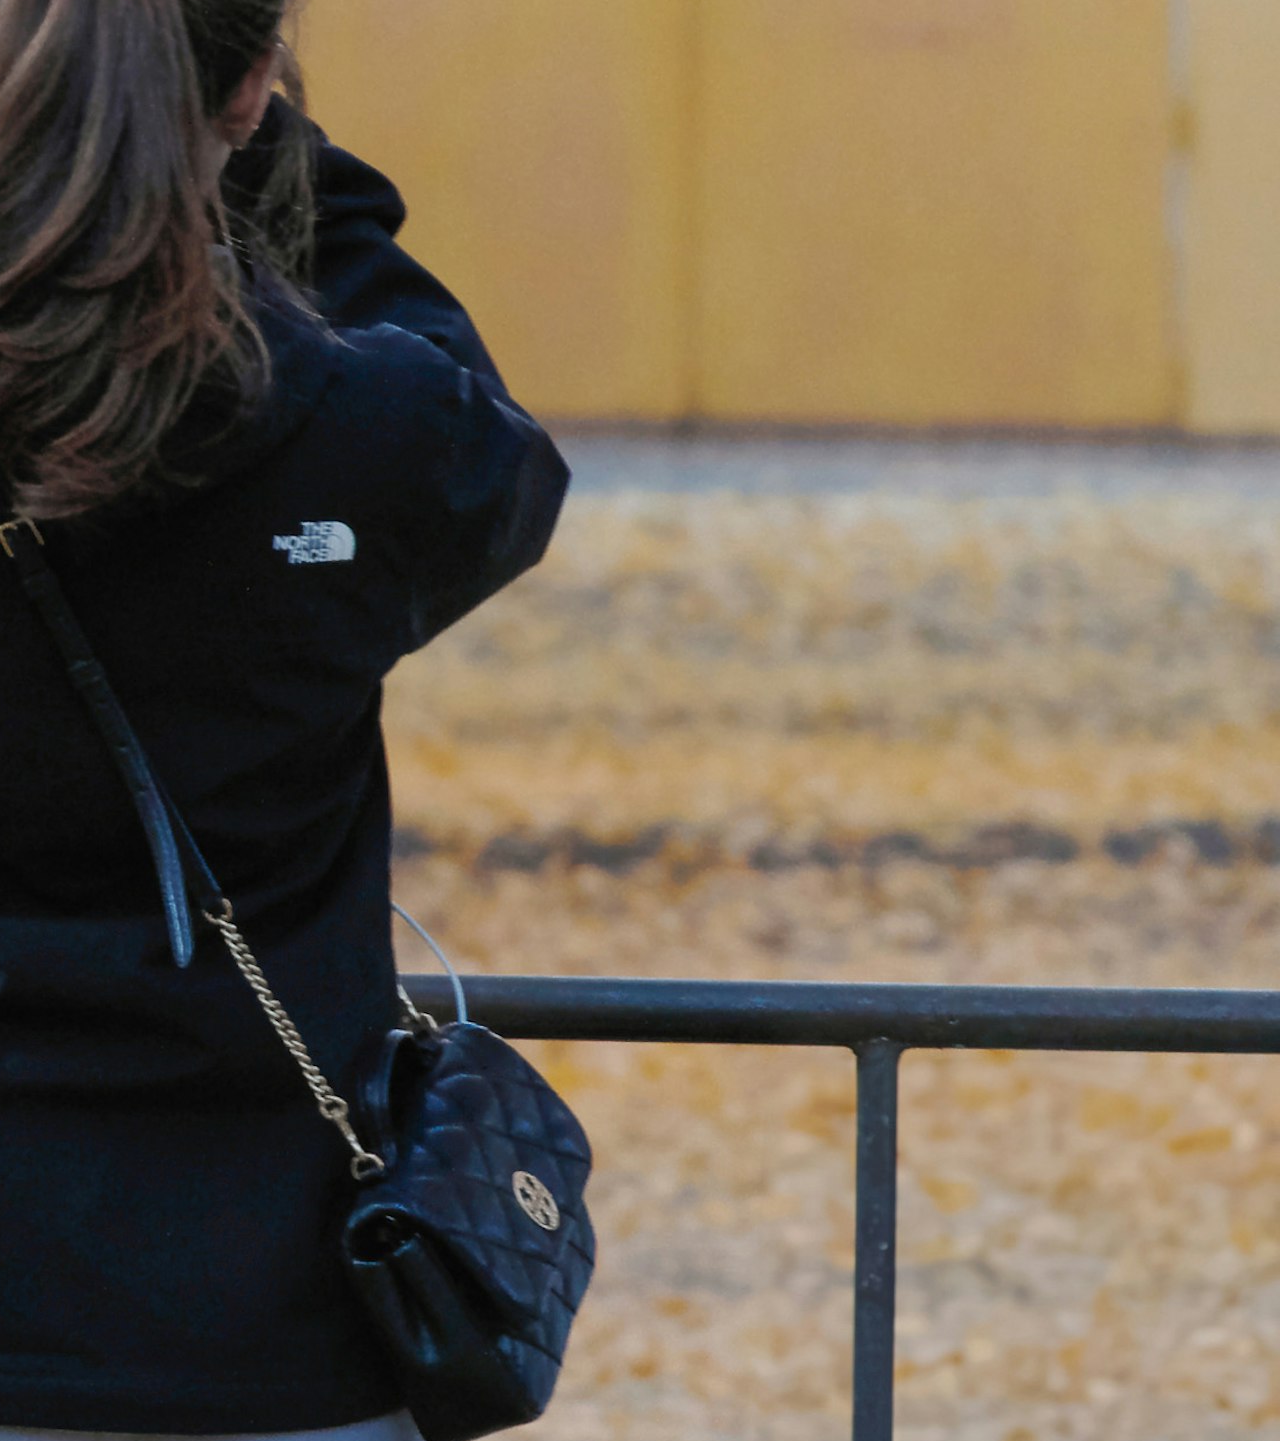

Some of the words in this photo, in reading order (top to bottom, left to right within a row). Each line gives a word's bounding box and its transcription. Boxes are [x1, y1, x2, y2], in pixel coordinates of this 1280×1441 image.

[301, 521, 332, 536] THE
[272, 535, 328, 550] NORTH
[288, 549, 329, 564] FACE
